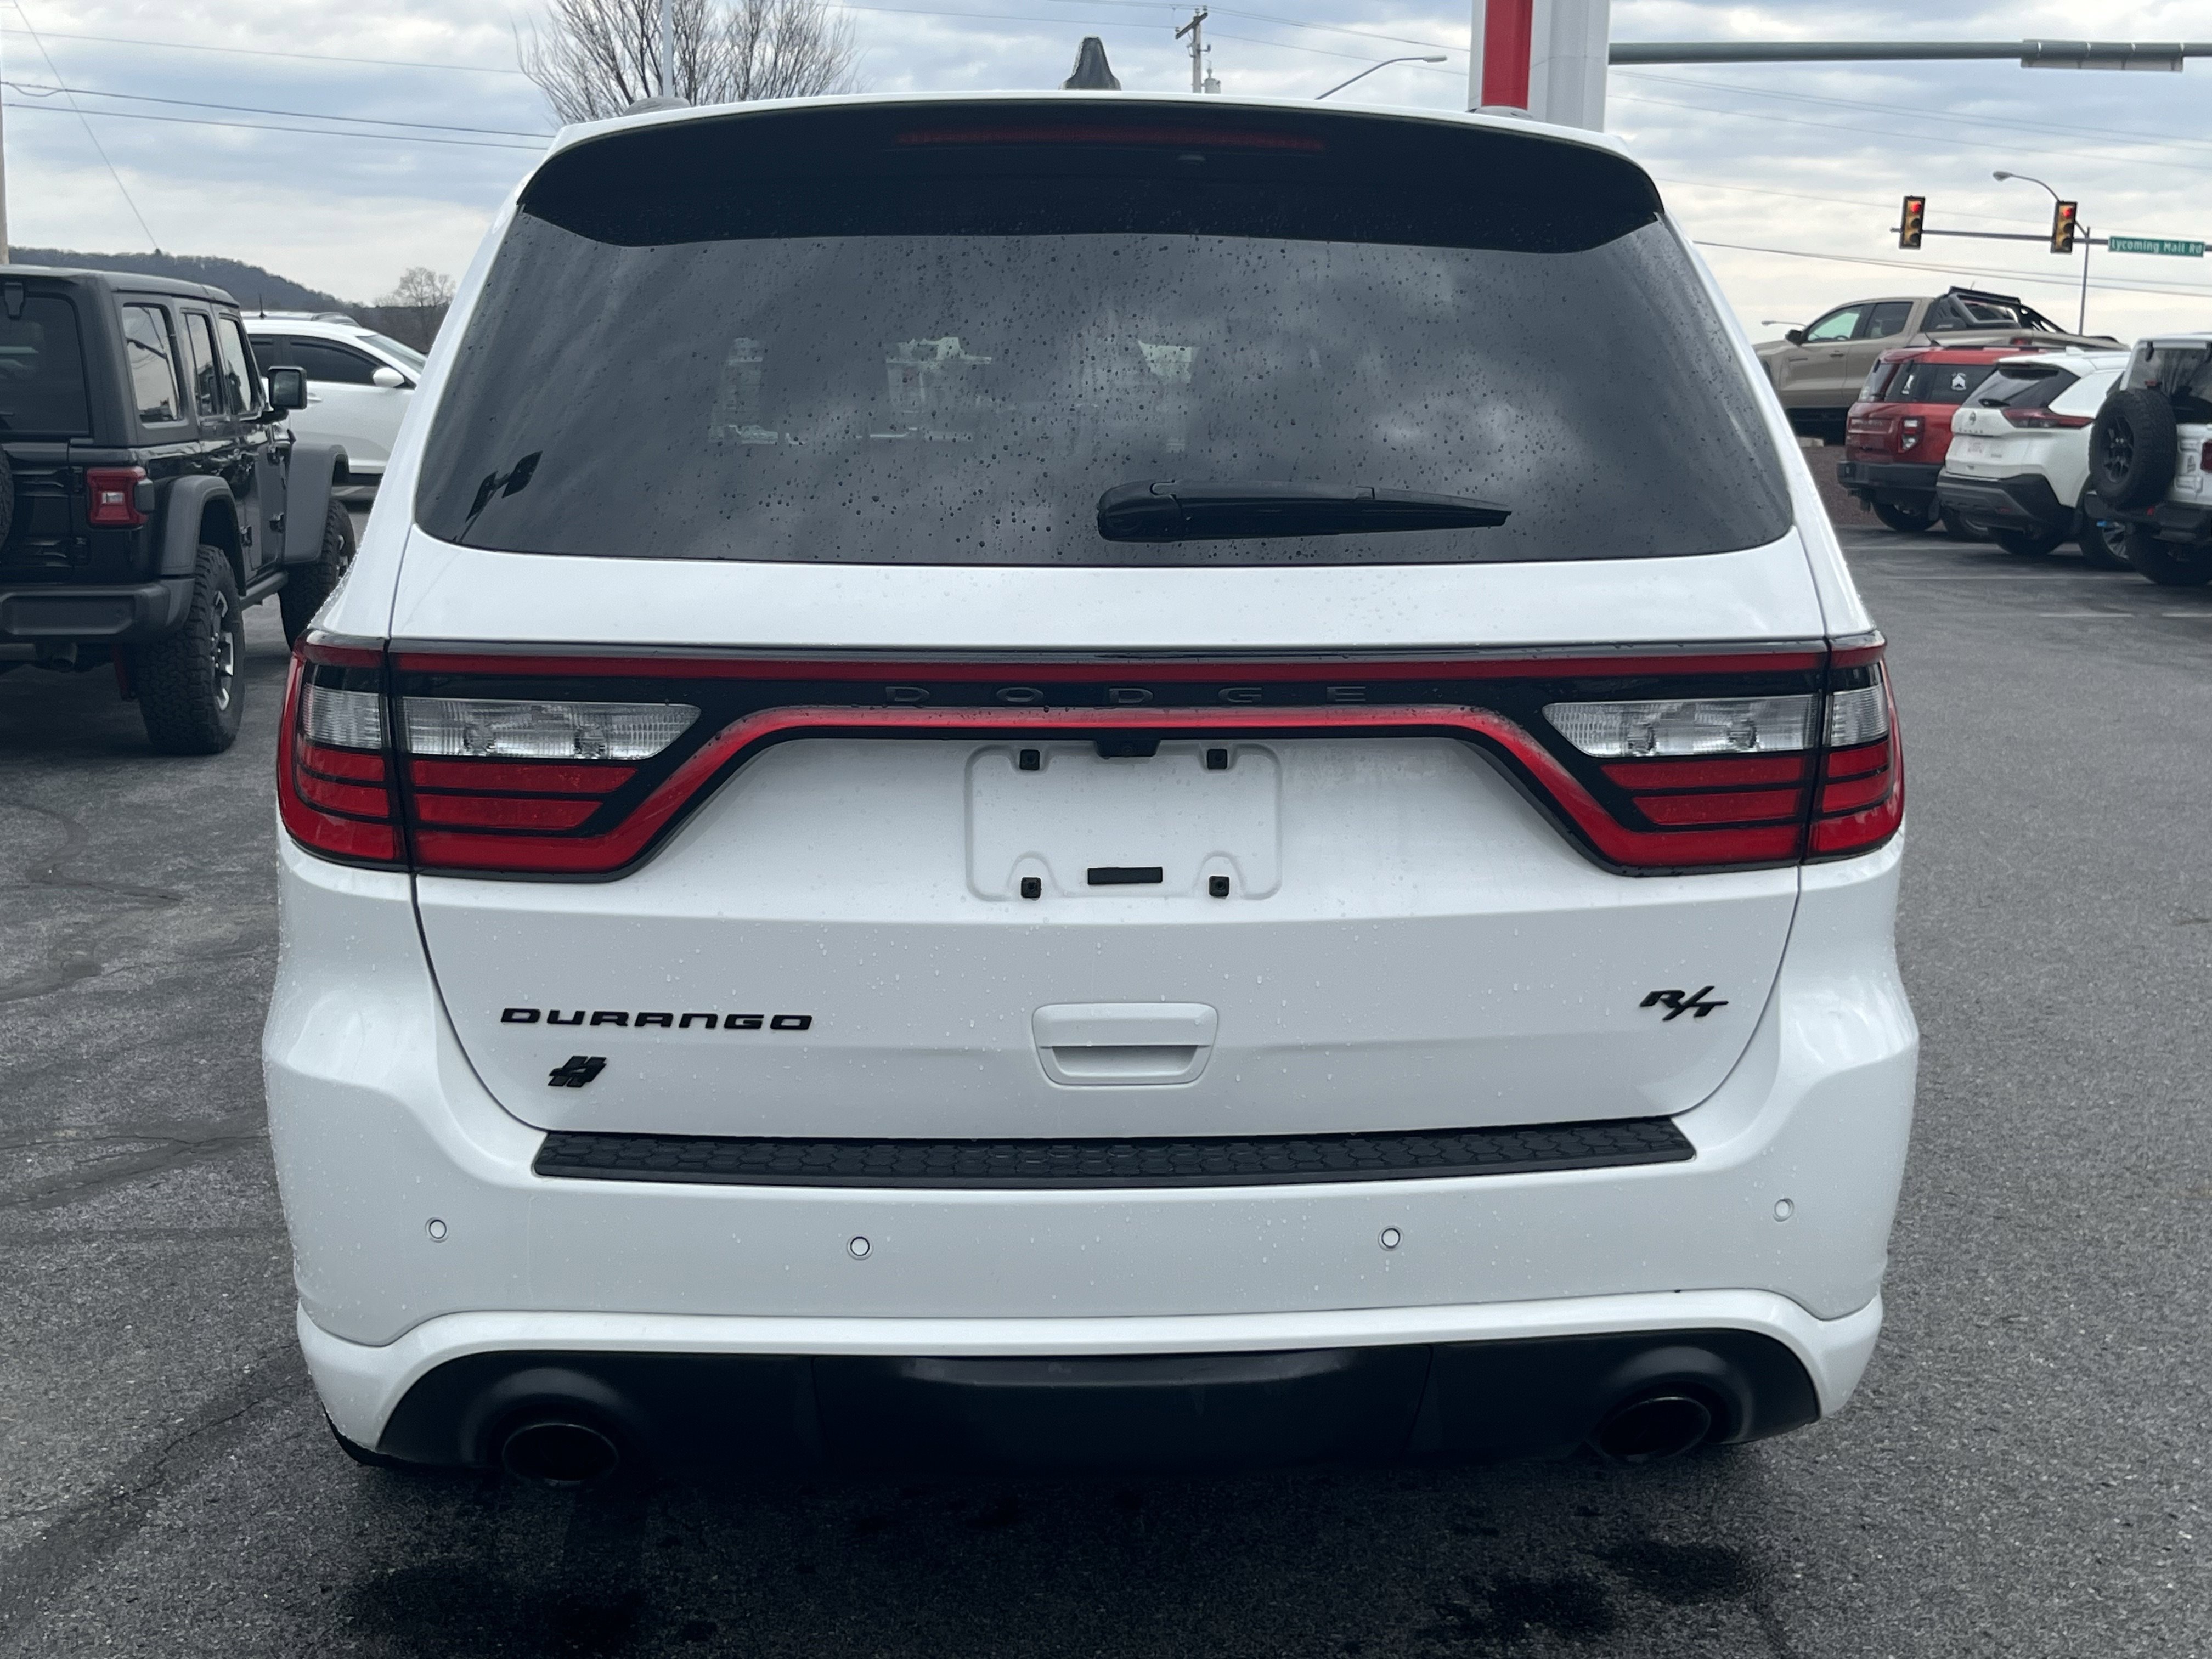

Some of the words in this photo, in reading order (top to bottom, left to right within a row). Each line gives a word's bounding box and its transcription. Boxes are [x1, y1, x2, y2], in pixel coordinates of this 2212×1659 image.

[2113, 238, 2159, 253] Lycoming
[2163, 242, 2185, 253] Mall
[2188, 243, 2203, 254] Rd
[885, 685, 1367, 704] DODGE
[1639, 985, 1729, 1022] R/T
[500, 1007, 813, 1031] DURANGO
